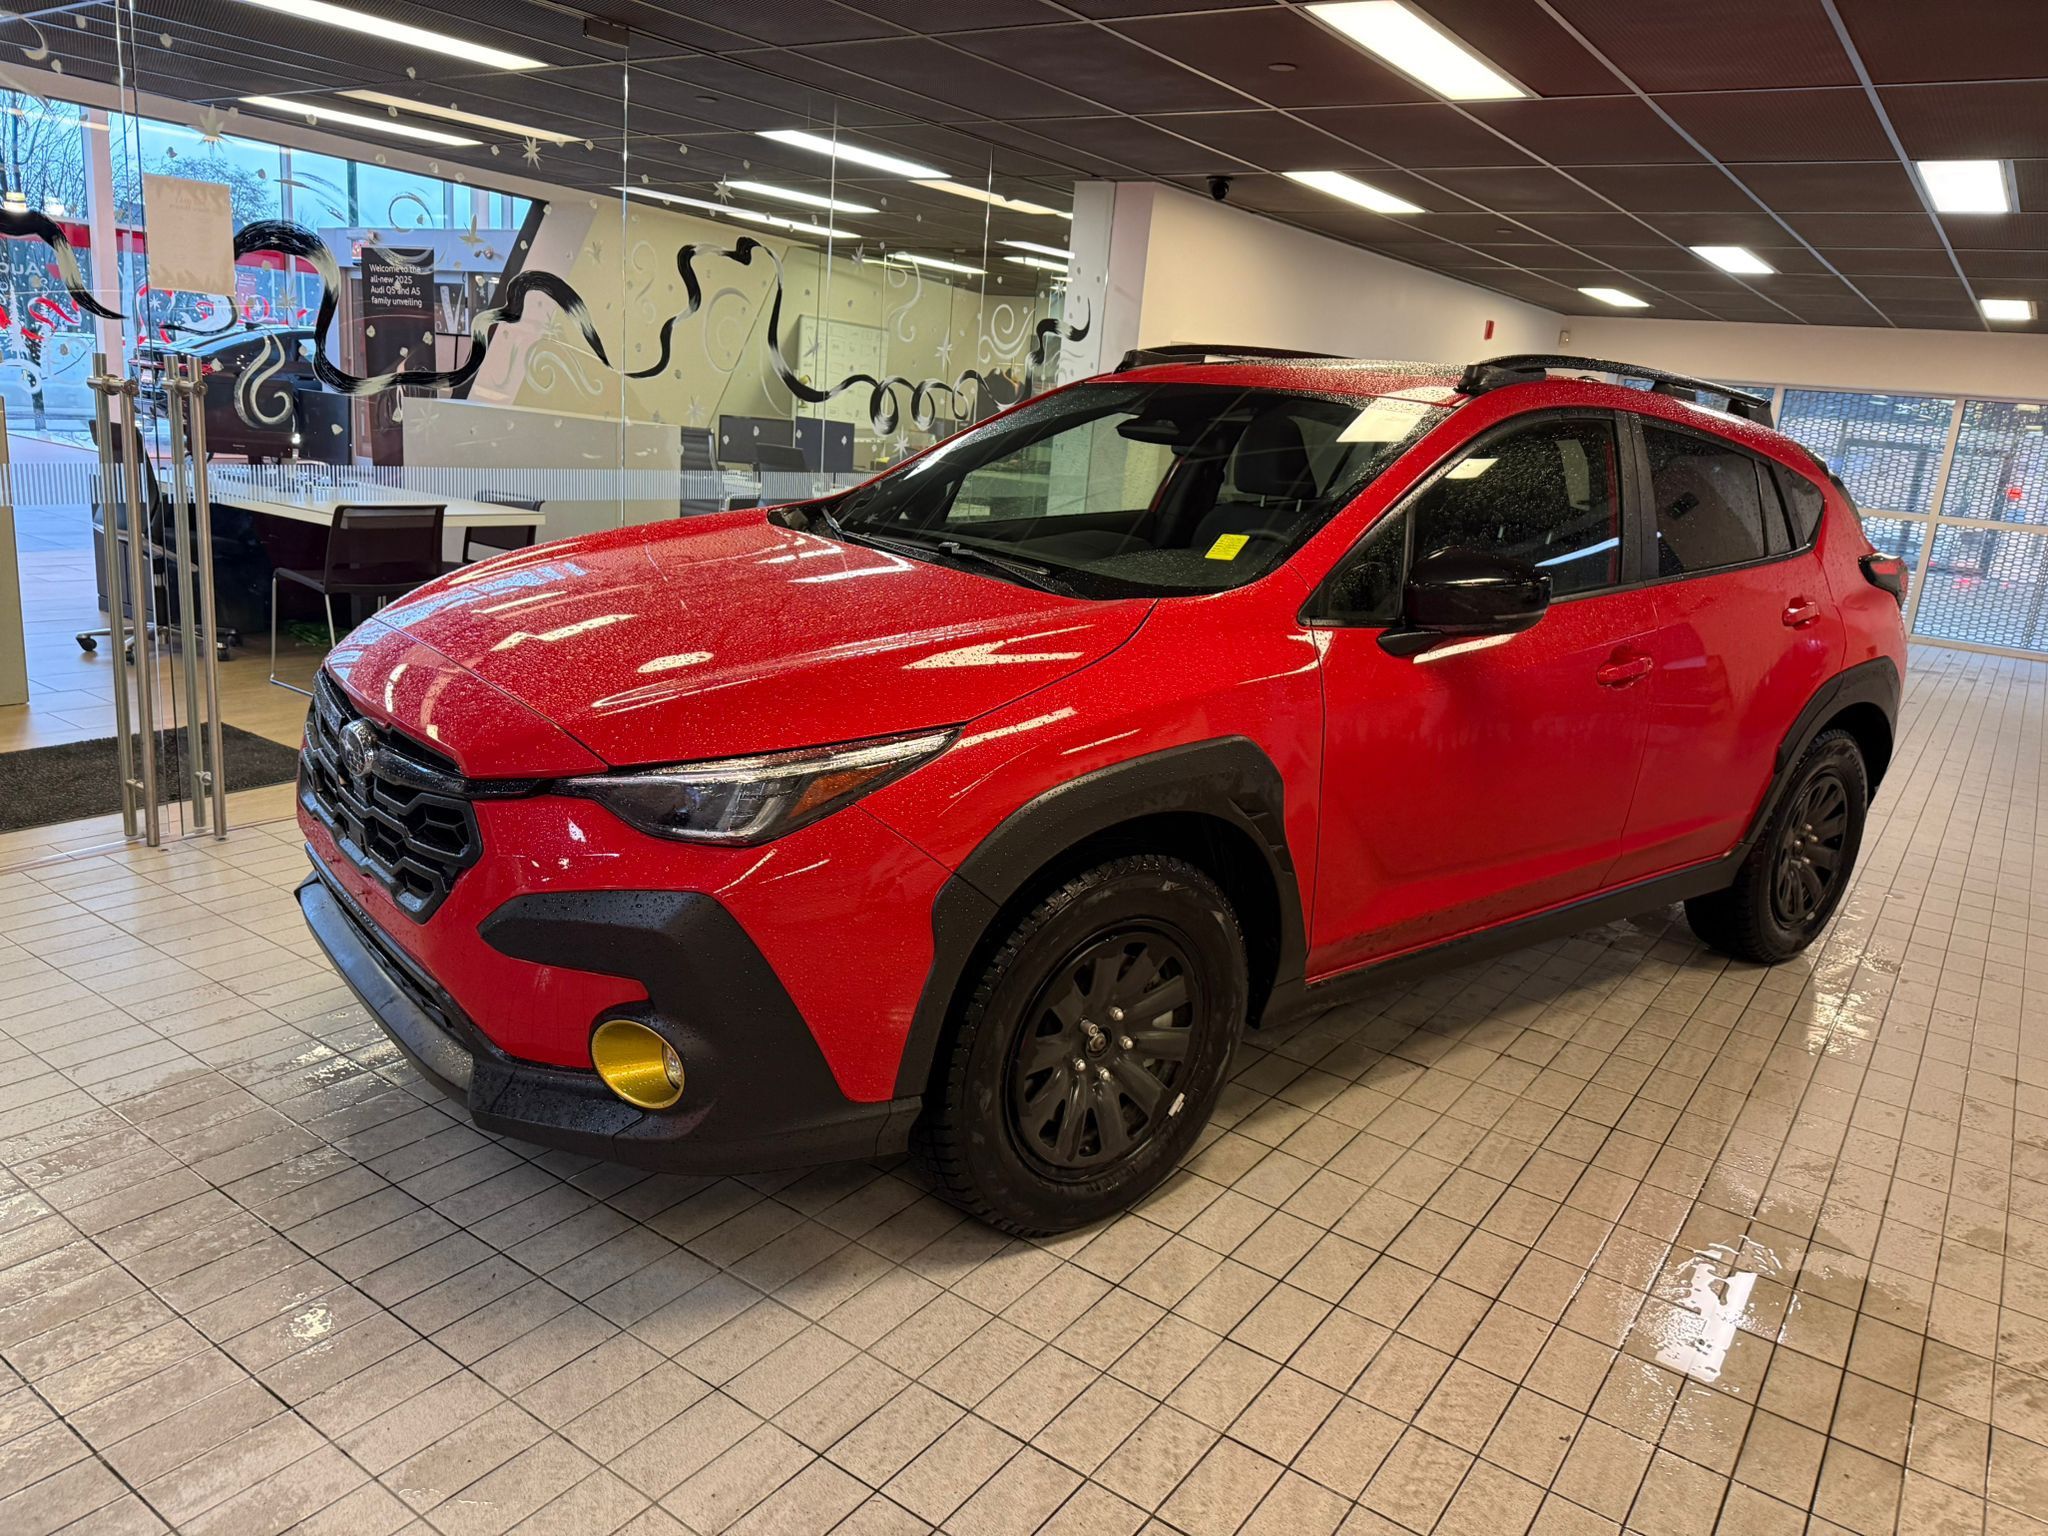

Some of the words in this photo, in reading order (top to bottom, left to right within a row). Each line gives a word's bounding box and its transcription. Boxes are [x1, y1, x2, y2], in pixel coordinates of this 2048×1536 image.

[369, 264, 400, 273] Welcome
[401, 265, 408, 273] to
[409, 264, 421, 273] the
[370, 274, 393, 284] all-new
[395, 275, 413, 284] 2025
[370, 285, 385, 294] Audi
[386, 286, 396, 295] Q5
[397, 287, 410, 295] and
[411, 287, 421, 296] A5
[371, 296, 391, 307] family
[393, 298, 422, 308] unveiling
